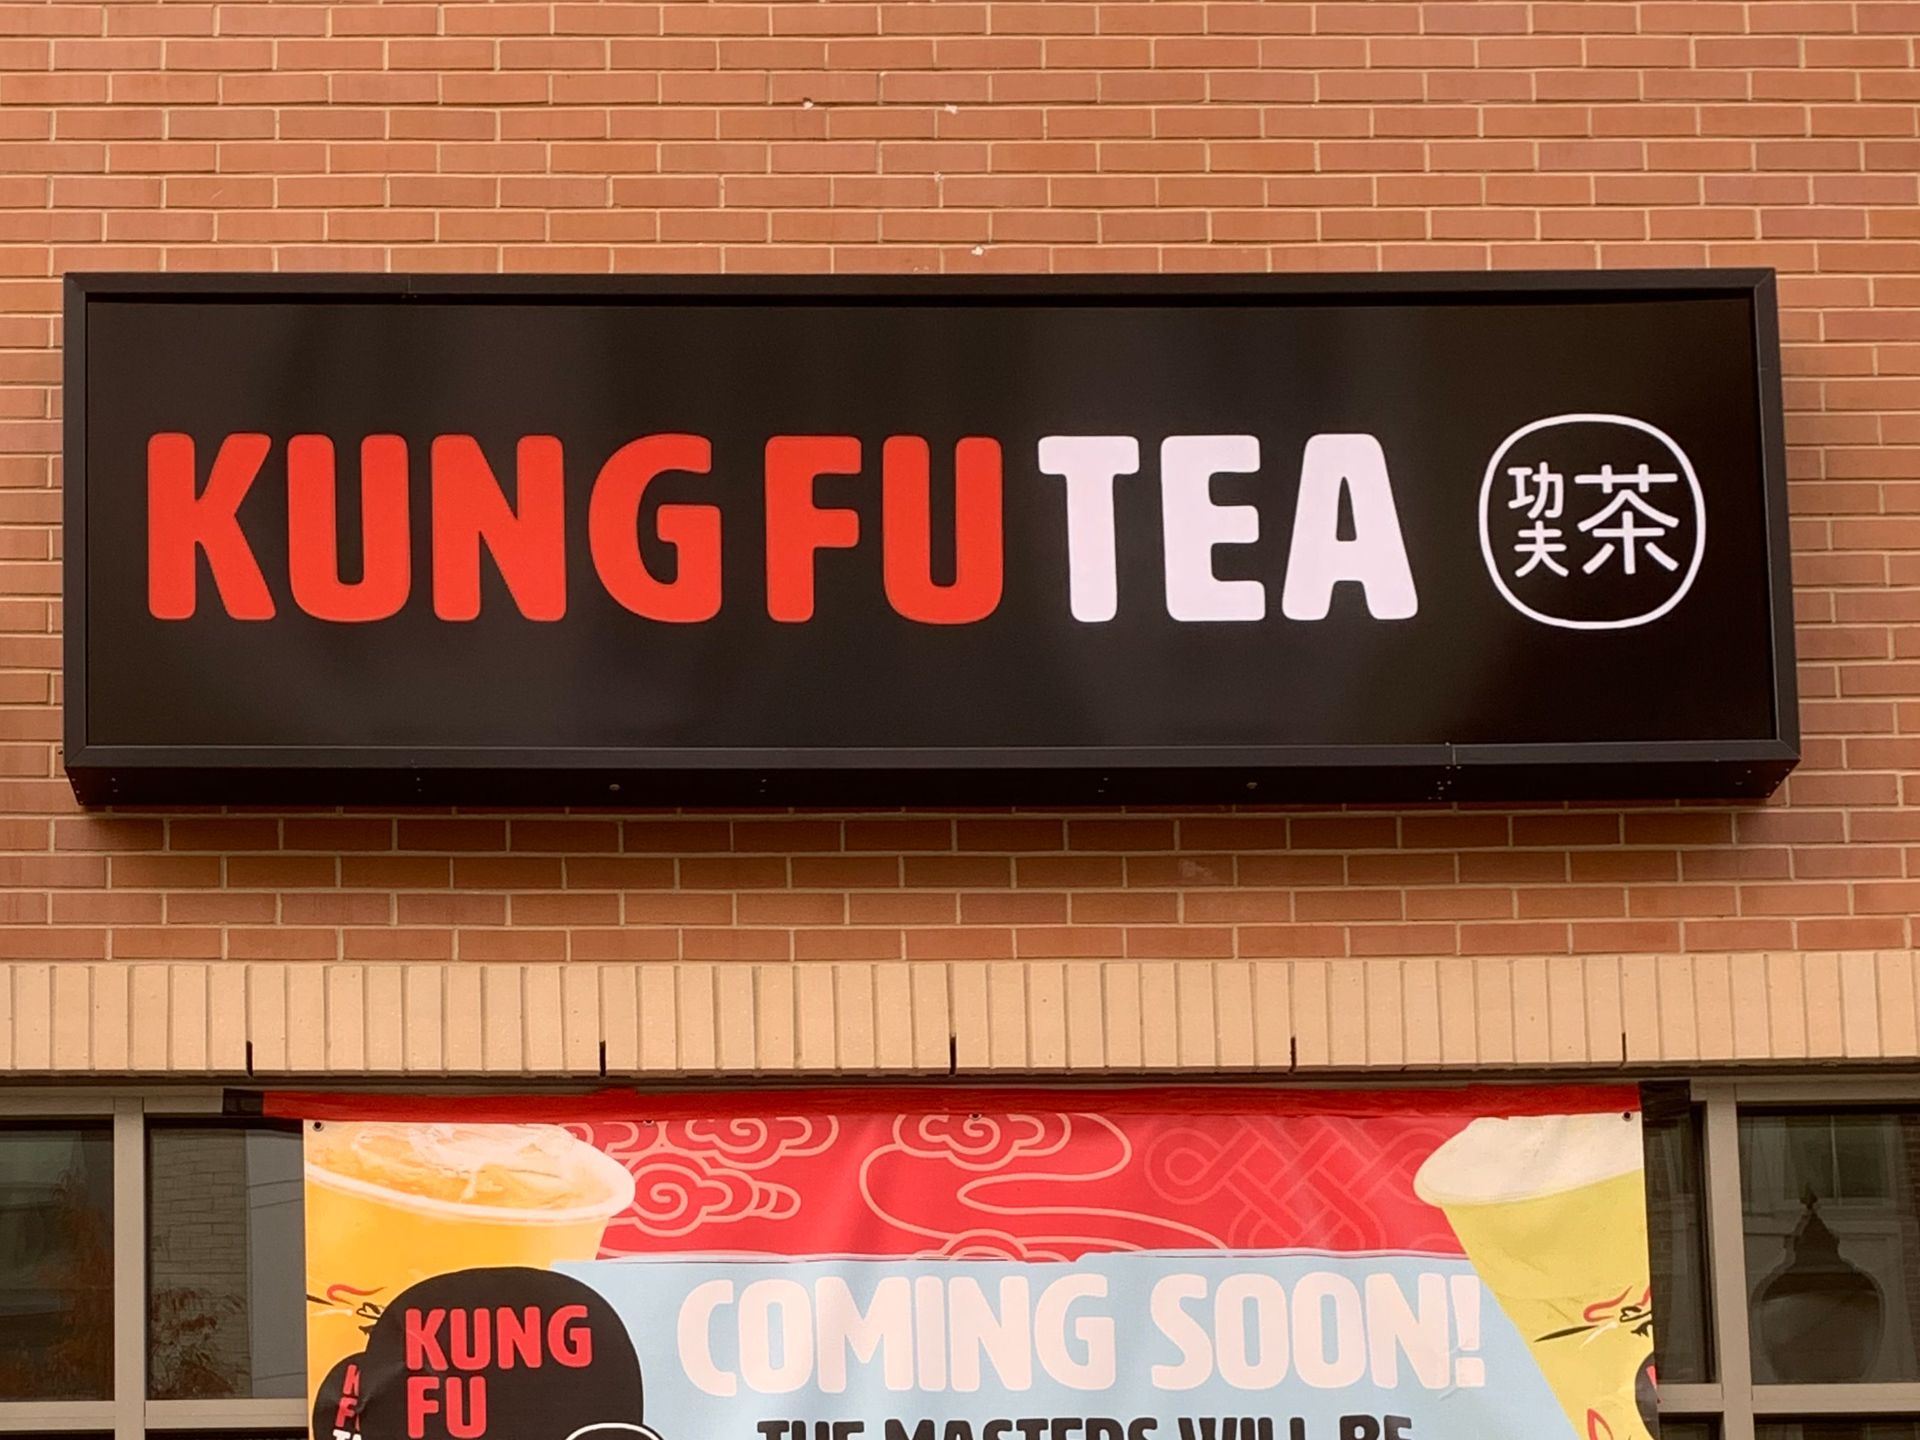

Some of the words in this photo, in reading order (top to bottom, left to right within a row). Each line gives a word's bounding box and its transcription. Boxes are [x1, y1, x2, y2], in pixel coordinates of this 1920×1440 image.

[147, 432, 723, 623] KUNG
[764, 435, 1004, 624] FU
[1037, 433, 1419, 622] TEA
[404, 1304, 593, 1372] KUNG
[676, 1272, 1117, 1397] COMING
[1150, 1271, 1487, 1391] SOON!
[406, 1375, 488, 1440] FU
